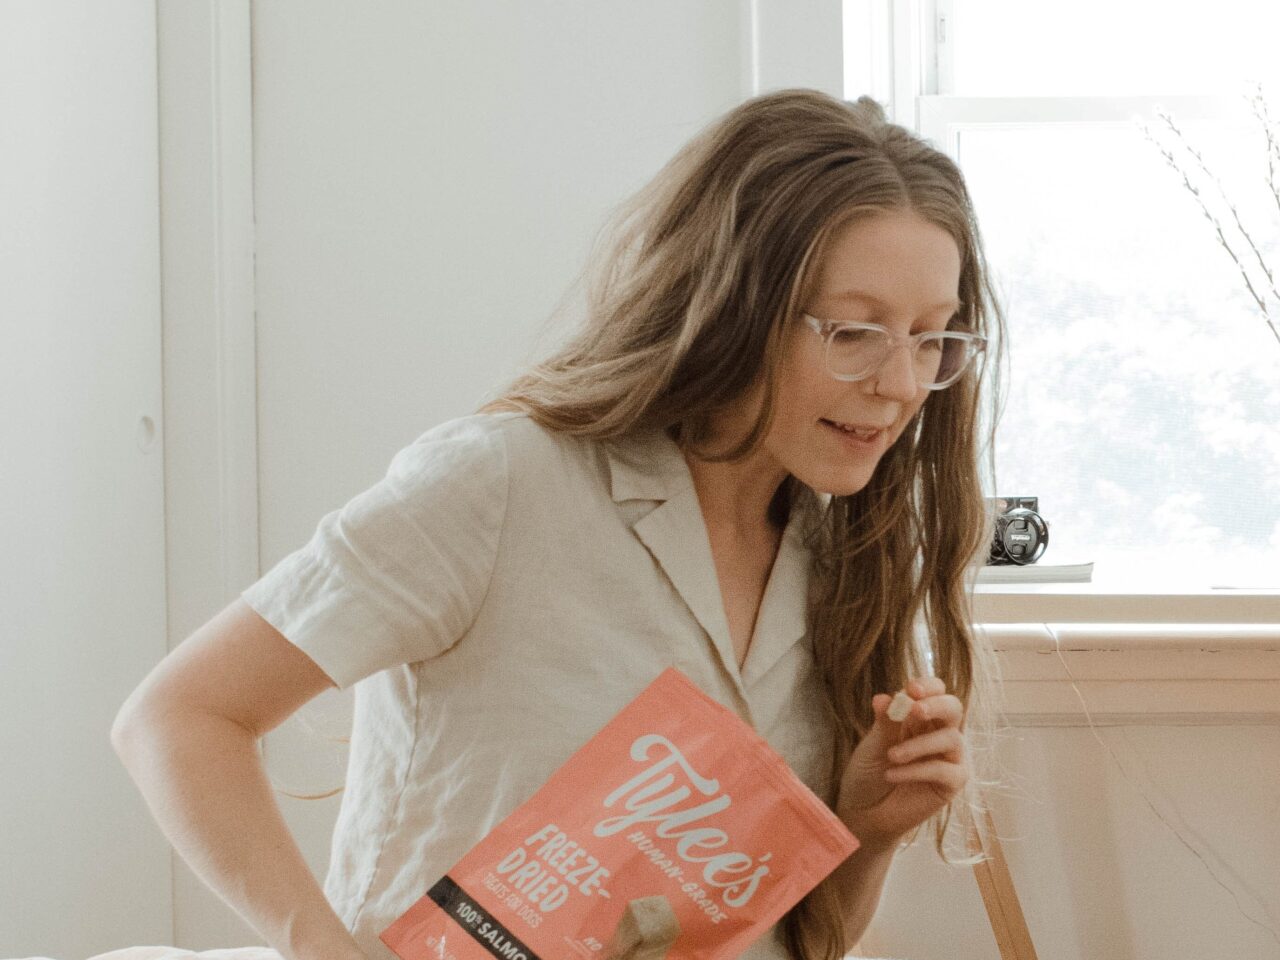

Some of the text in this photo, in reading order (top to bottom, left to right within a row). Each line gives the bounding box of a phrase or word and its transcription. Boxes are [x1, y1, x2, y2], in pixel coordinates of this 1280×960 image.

[593, 734, 772, 908] Tylee's
[496, 847, 569, 912] DRIED
[524, 823, 611, 899] FREEZE-
[627, 831, 729, 924] HUMAN-GRADE
[456, 902, 484, 924] 100%
[484, 871, 543, 929] TREATS FOR DOGS
